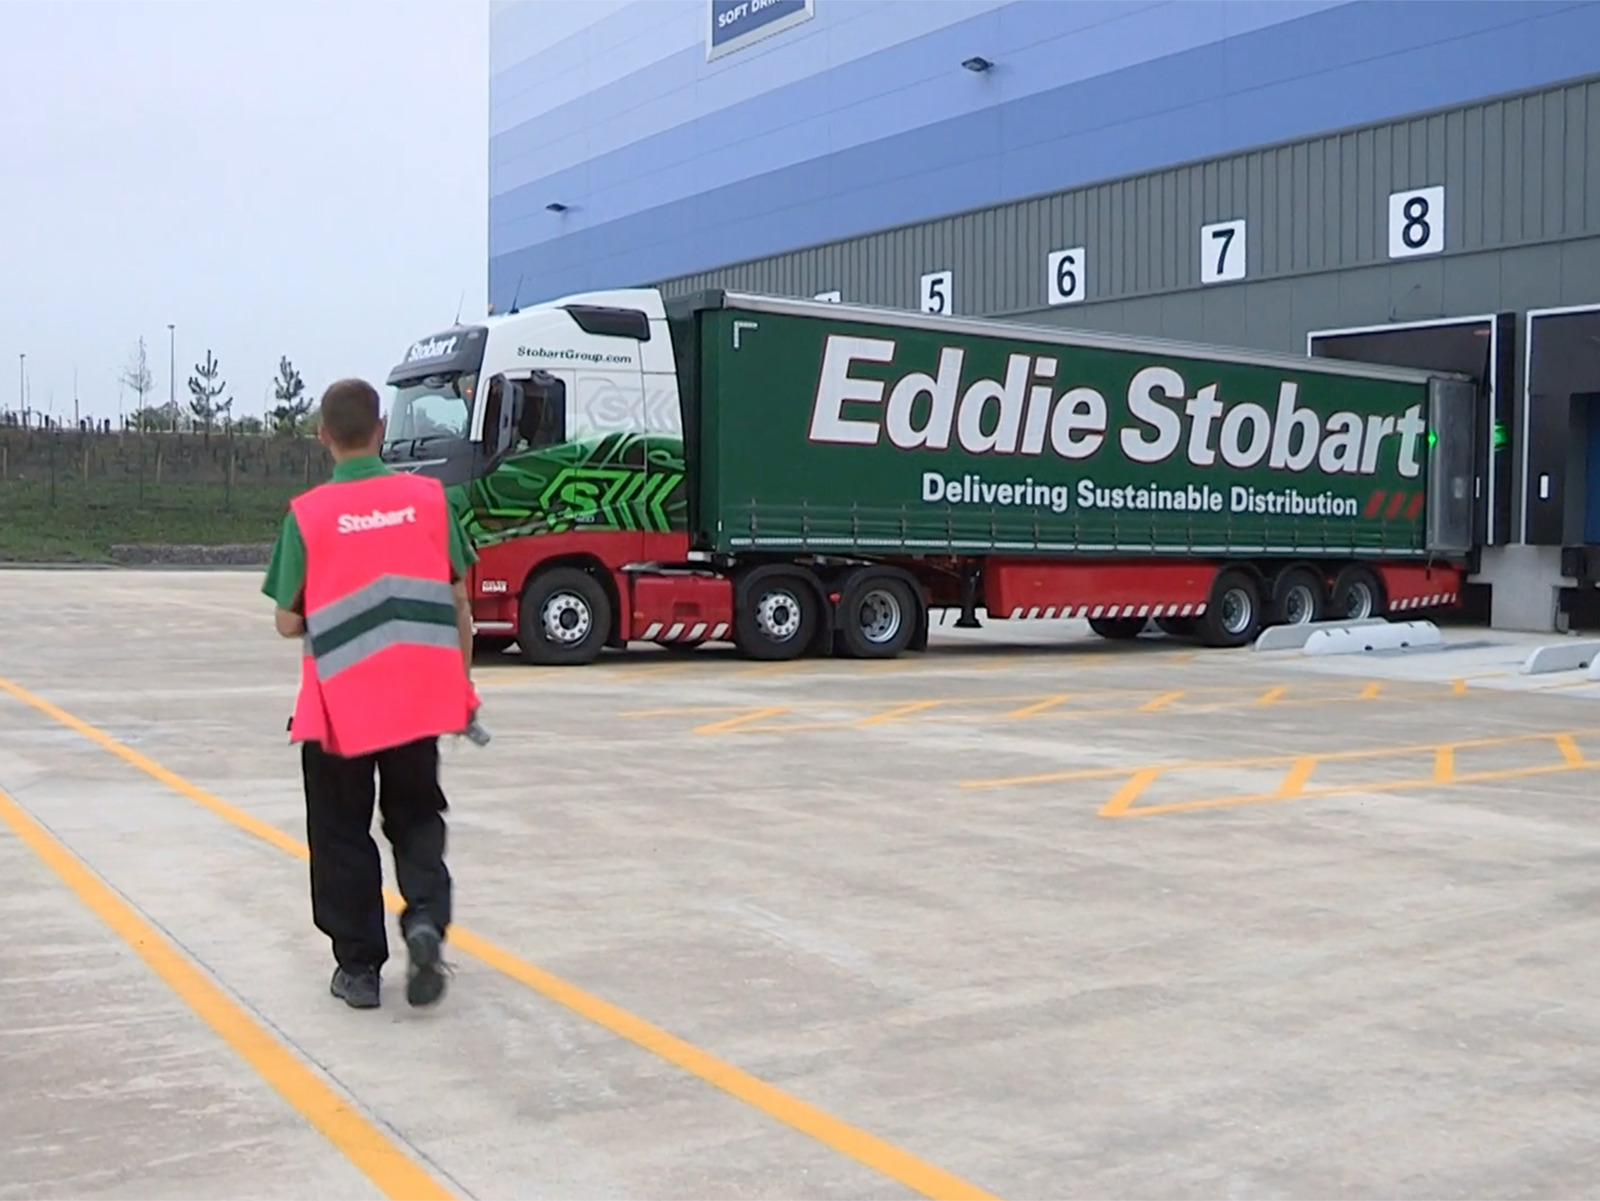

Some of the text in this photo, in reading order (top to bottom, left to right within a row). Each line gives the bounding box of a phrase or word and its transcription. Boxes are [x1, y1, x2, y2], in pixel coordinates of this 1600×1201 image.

[718, 3, 749, 28] SOFT
[1402, 196, 1430, 248] 8
[1210, 228, 1236, 274] 7
[928, 278, 945, 313] 5
[1055, 255, 1077, 298] 6
[517, 346, 632, 364] StobartGroup.com
[808, 334, 1424, 478] Eddie Stobart
[921, 472, 1358, 518] Delivering Sustainable Distribution
[337, 507, 417, 534] Stobart
